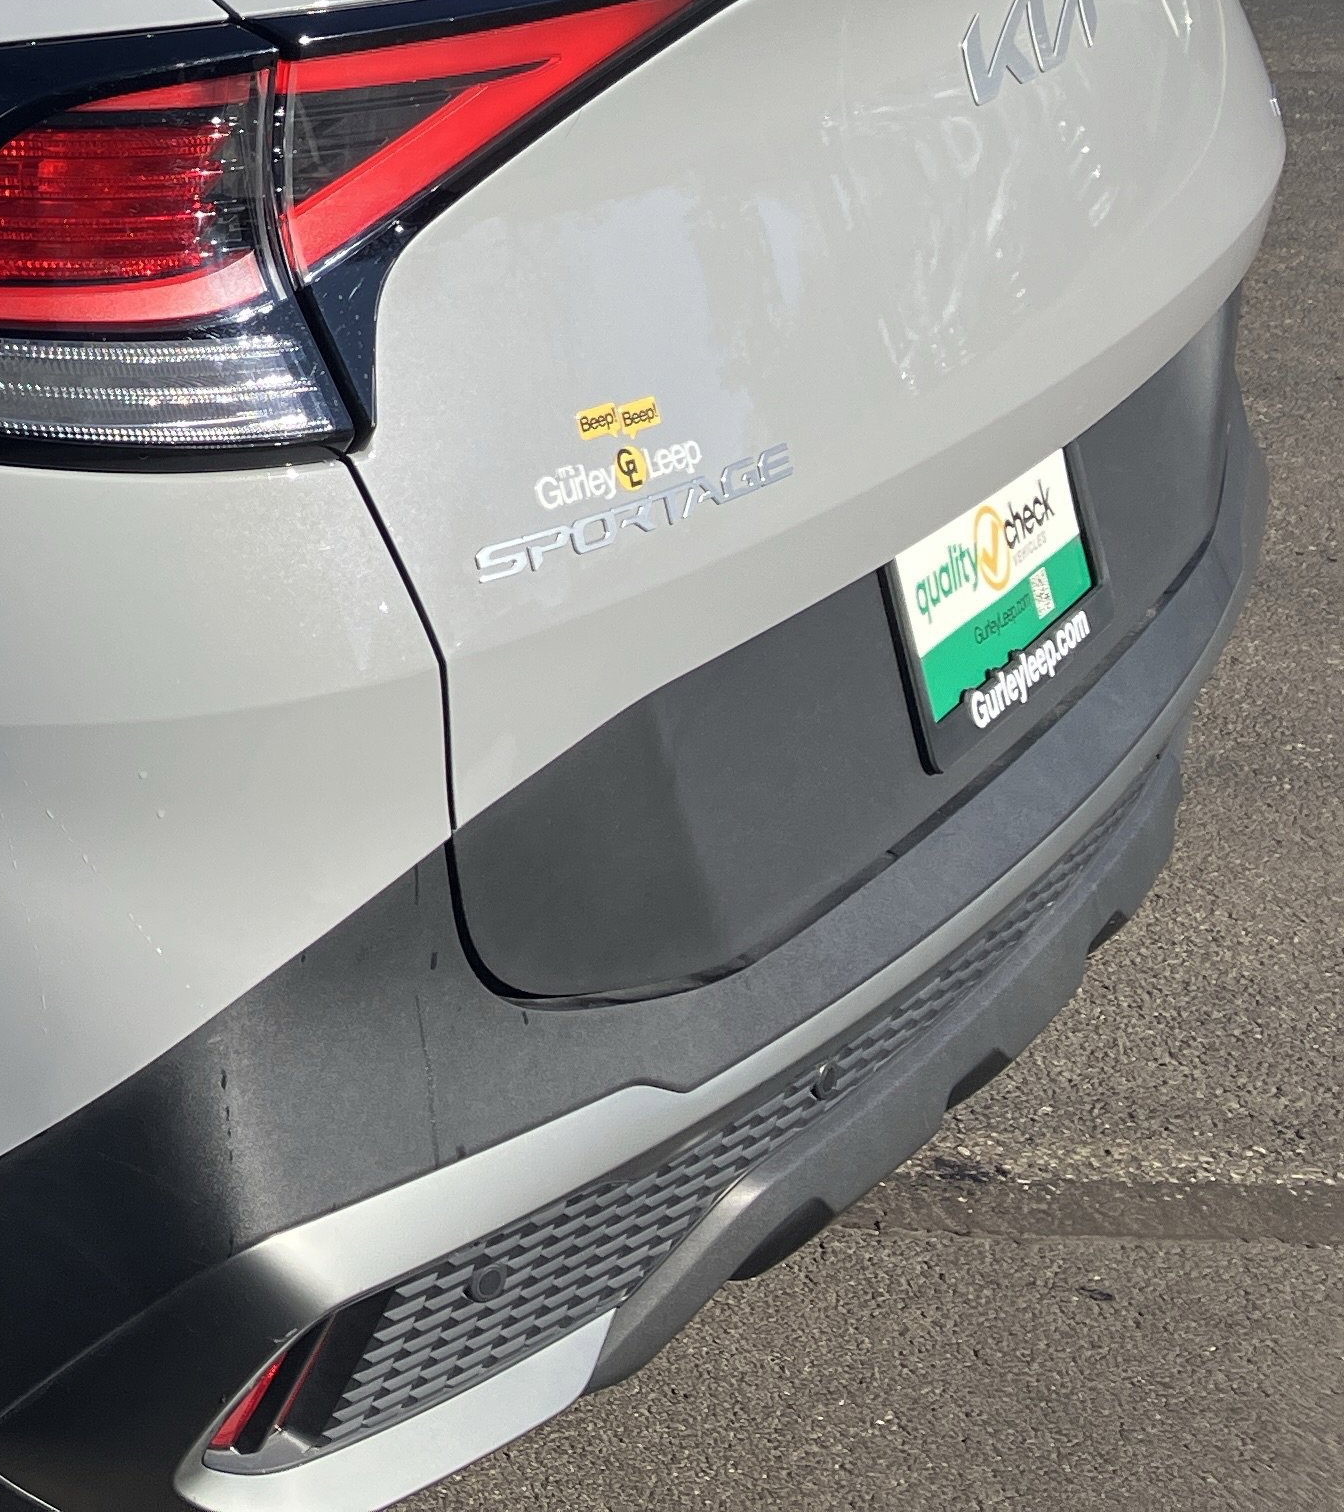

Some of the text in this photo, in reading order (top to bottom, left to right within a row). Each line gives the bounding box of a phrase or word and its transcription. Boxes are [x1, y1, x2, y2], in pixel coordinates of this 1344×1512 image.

[534, 464, 617, 510] Gurley
[641, 440, 702, 479] Leep
[579, 402, 659, 433] Beep! Beep!
[474, 442, 794, 584] SPORTAGE
[915, 479, 1056, 625] quality check
[971, 610, 1091, 729] Gurleyleep.com
